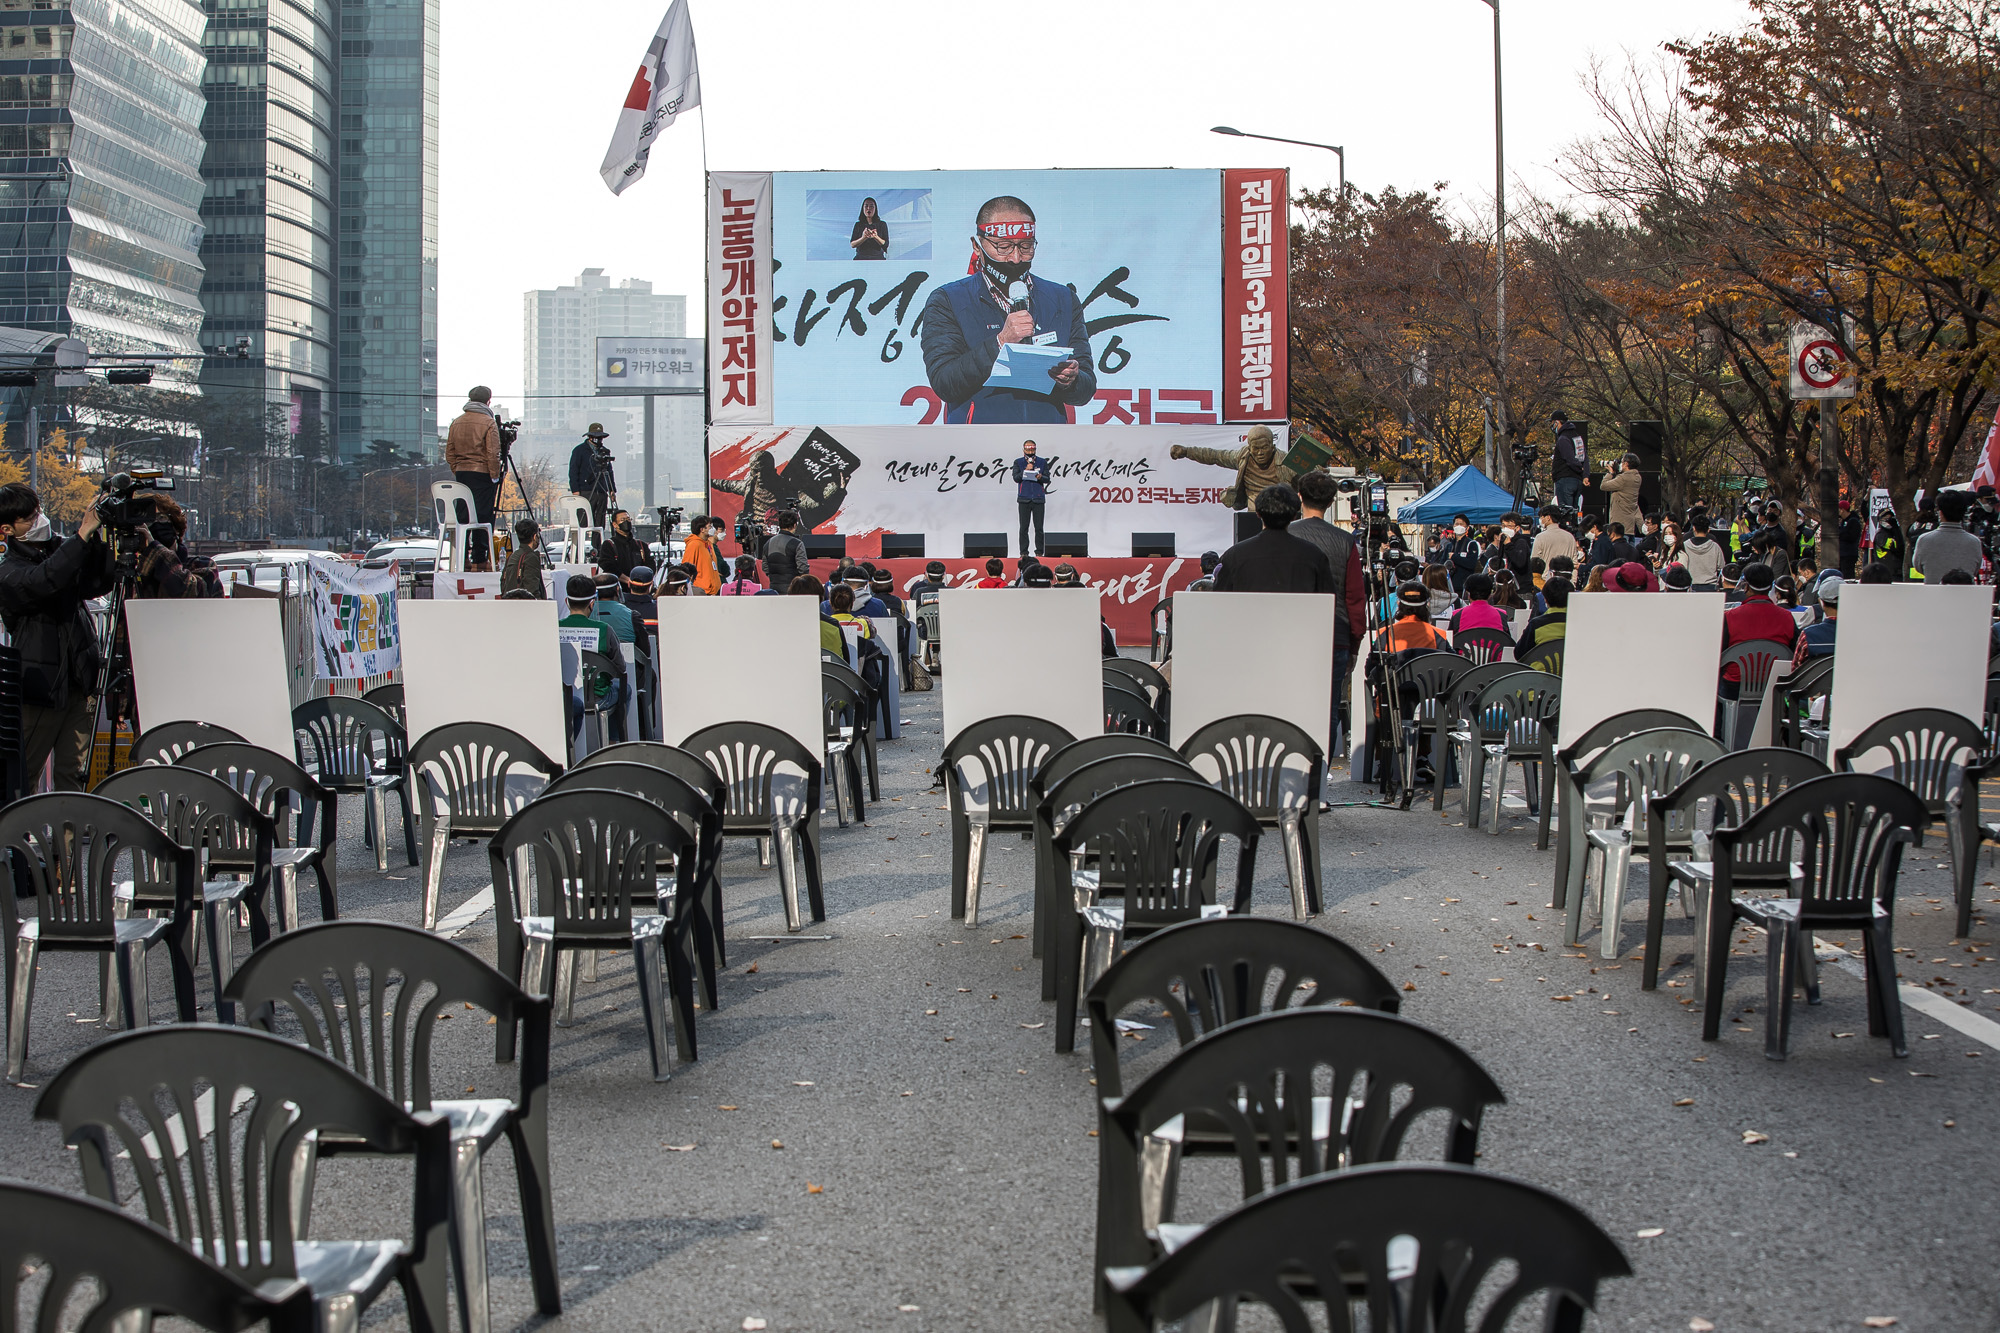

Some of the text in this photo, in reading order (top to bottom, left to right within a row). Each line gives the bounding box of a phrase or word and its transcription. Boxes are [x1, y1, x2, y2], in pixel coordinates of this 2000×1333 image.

[721, 189, 757, 407] 노동개악저지
[1240, 179, 1272, 413] 전태일3법쟁취
[631, 360, 694, 374] 카카오워크
[1089, 487, 1134, 504] 2020
